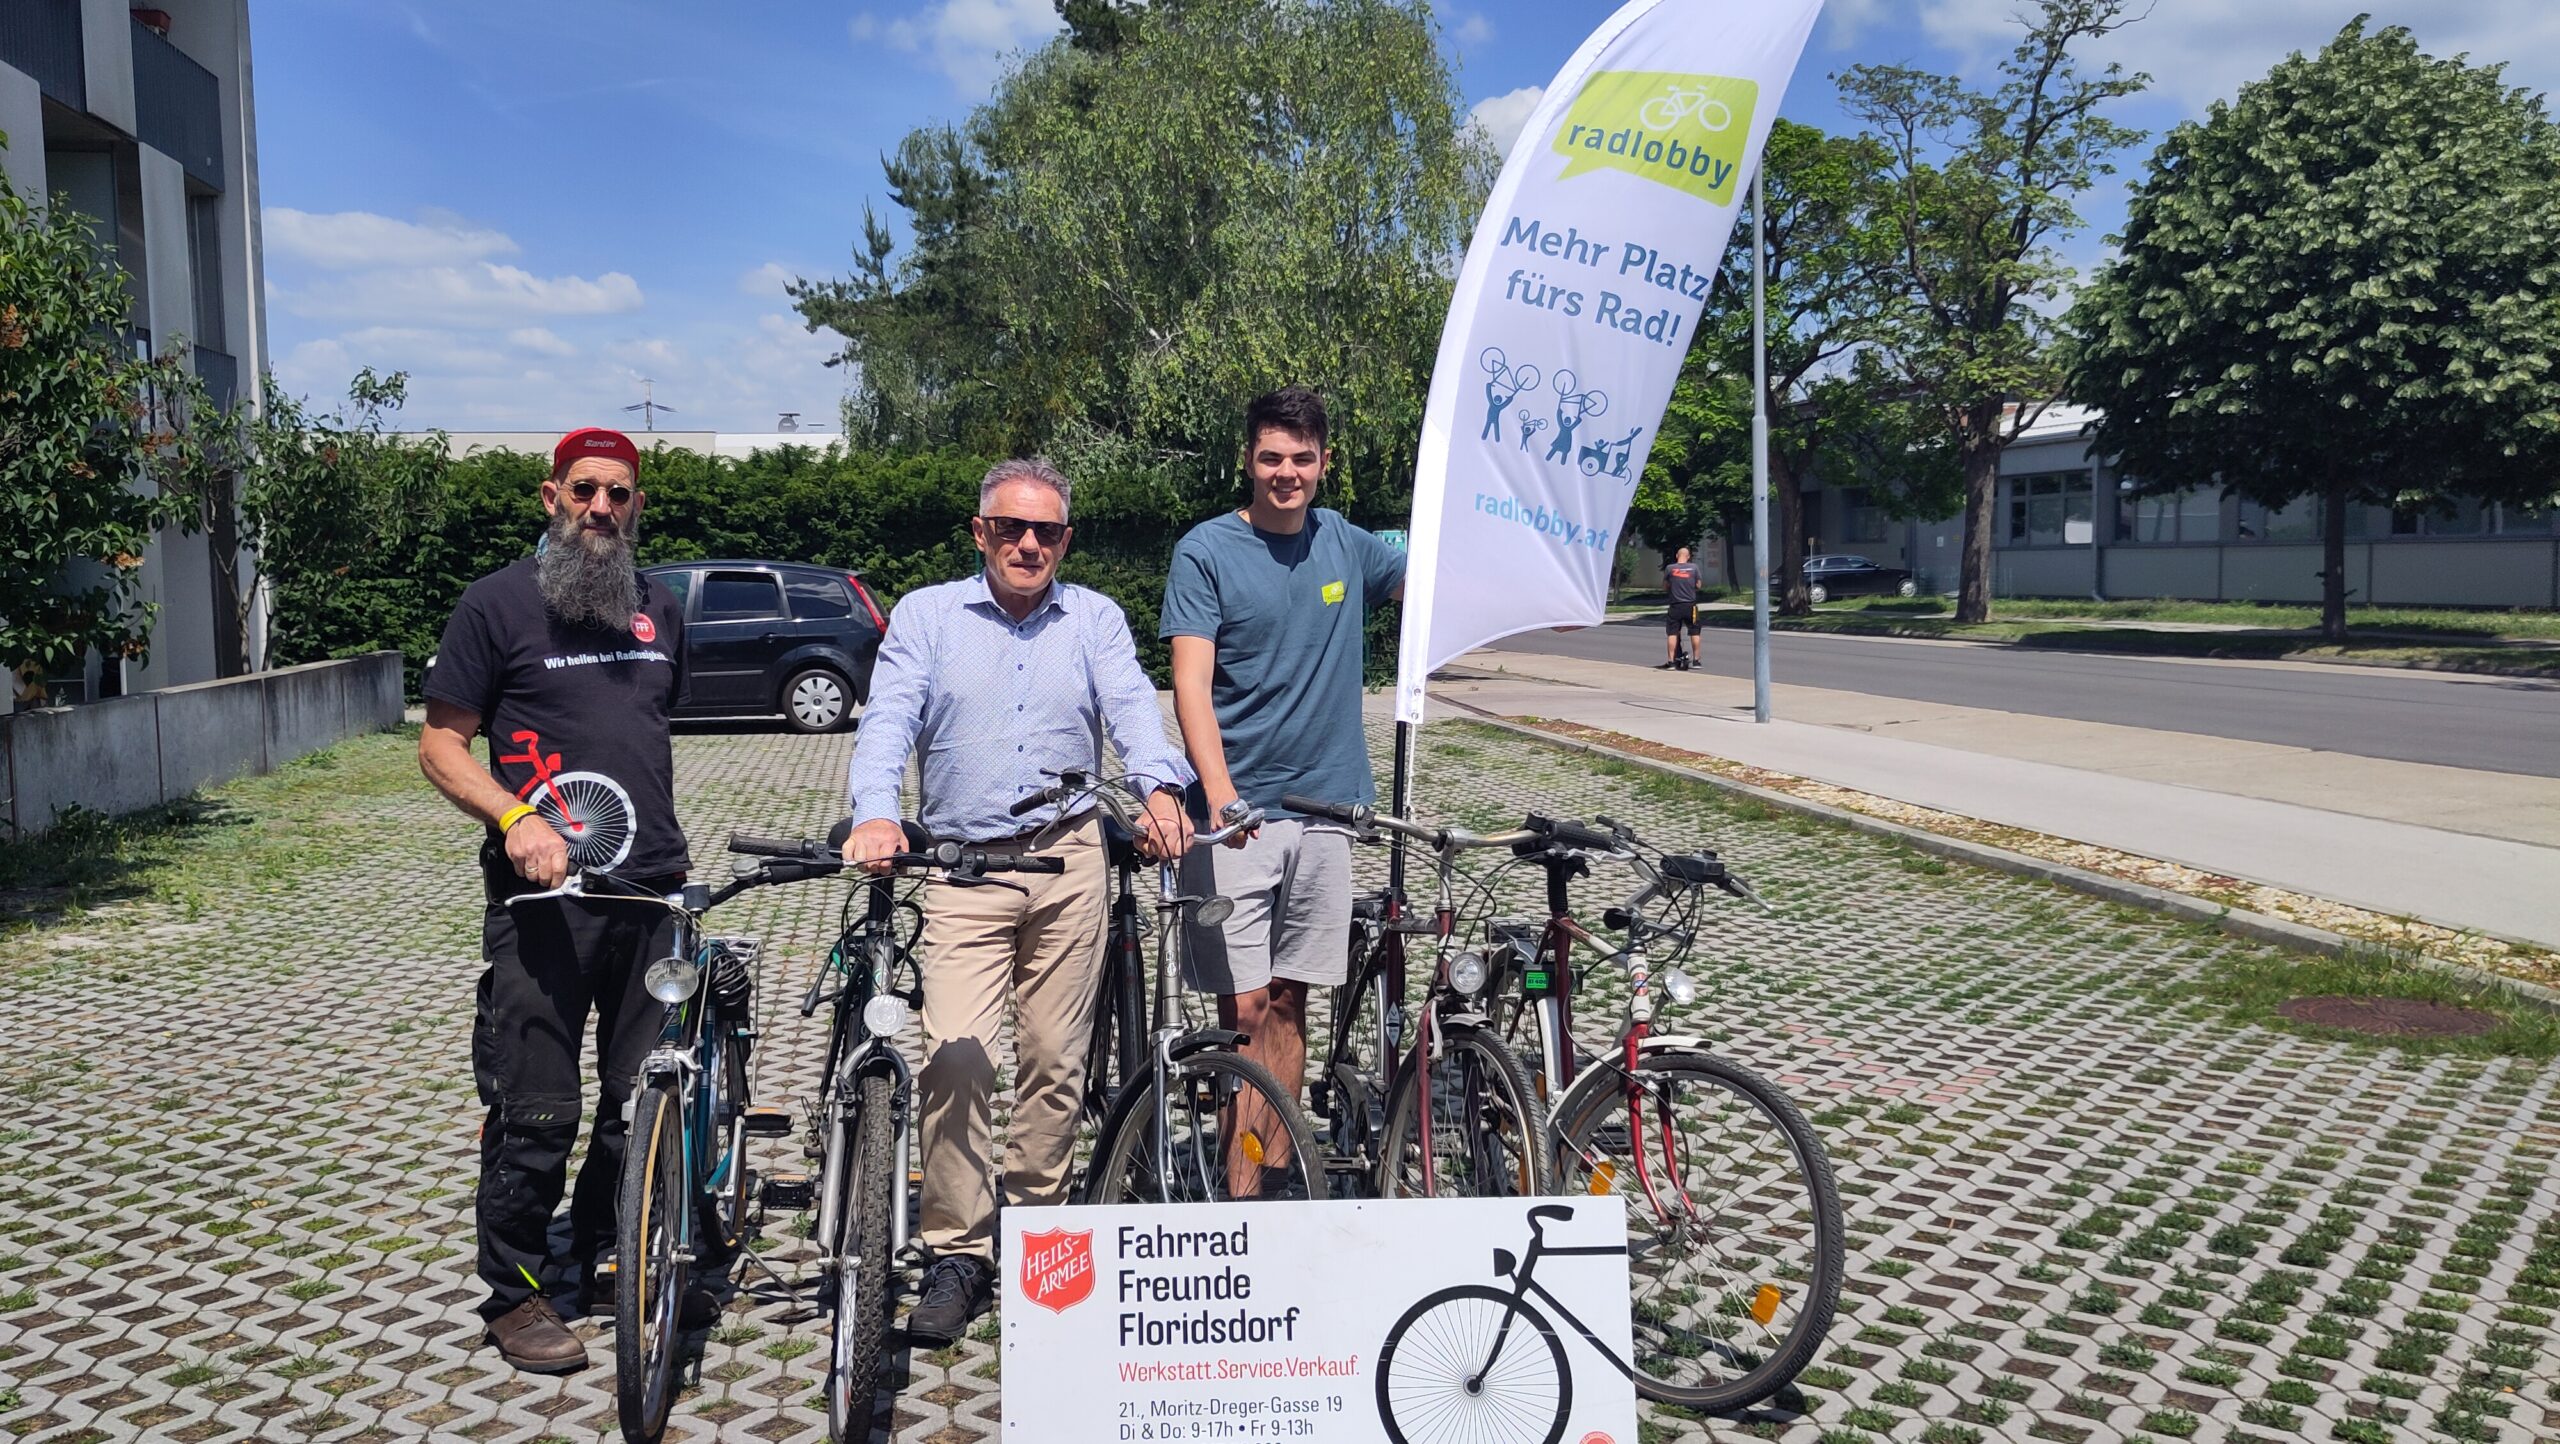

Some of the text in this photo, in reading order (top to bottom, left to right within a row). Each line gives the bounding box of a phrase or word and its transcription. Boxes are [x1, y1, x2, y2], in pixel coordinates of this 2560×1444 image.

[1568, 124, 1733, 190] radlobby
[1501, 216, 1709, 302] Mehr Platz
[1505, 269, 1682, 347] fürs Rad!
[1474, 493, 1609, 551] radlobby.at
[544, 658, 565, 669] Wir
[567, 654, 599, 666] helfen
[599, 653, 615, 662] bei
[1026, 1236, 1081, 1282] HEILS-
[1118, 1222, 1248, 1259] Fahrrad
[1035, 1251, 1090, 1300] ARMEE
[1119, 1265, 1251, 1303] Freunde
[1119, 1306, 1300, 1346] Floridsdorf
[1118, 1354, 1360, 1382] Werkstatt.Service.Verkauf.
[1119, 1395, 1343, 1420] 21., Moritz-Dreger-Gasse 19
[1120, 1418, 1313, 1441] Di & Do: 9-17h Fr 9-13h
